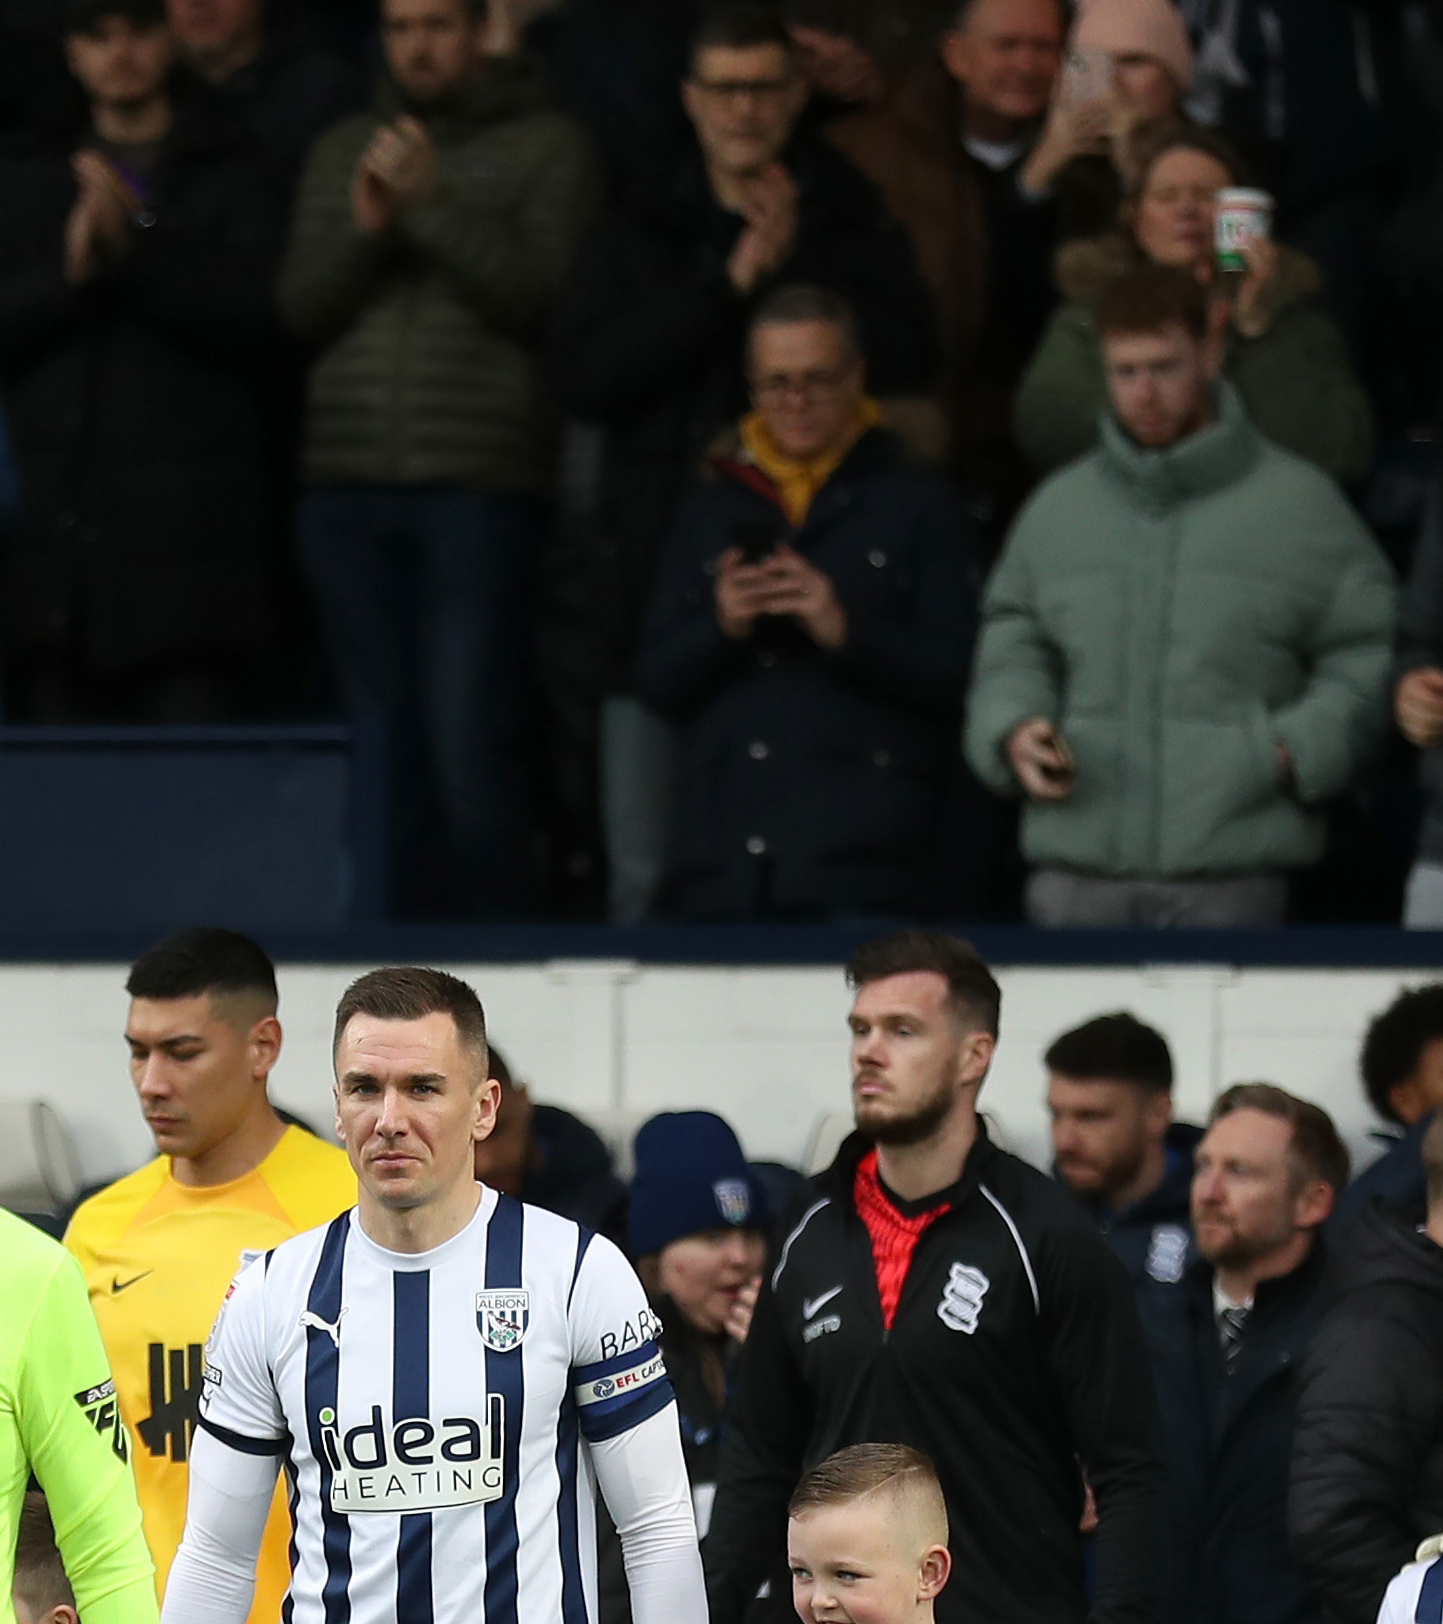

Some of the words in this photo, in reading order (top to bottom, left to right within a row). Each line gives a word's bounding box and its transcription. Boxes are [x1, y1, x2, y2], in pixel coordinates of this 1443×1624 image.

[478, 1298, 526, 1309] ALBION
[616, 1373, 640, 1389] EFL
[321, 1394, 502, 1471] ideal
[332, 1466, 501, 1500] HEATING
